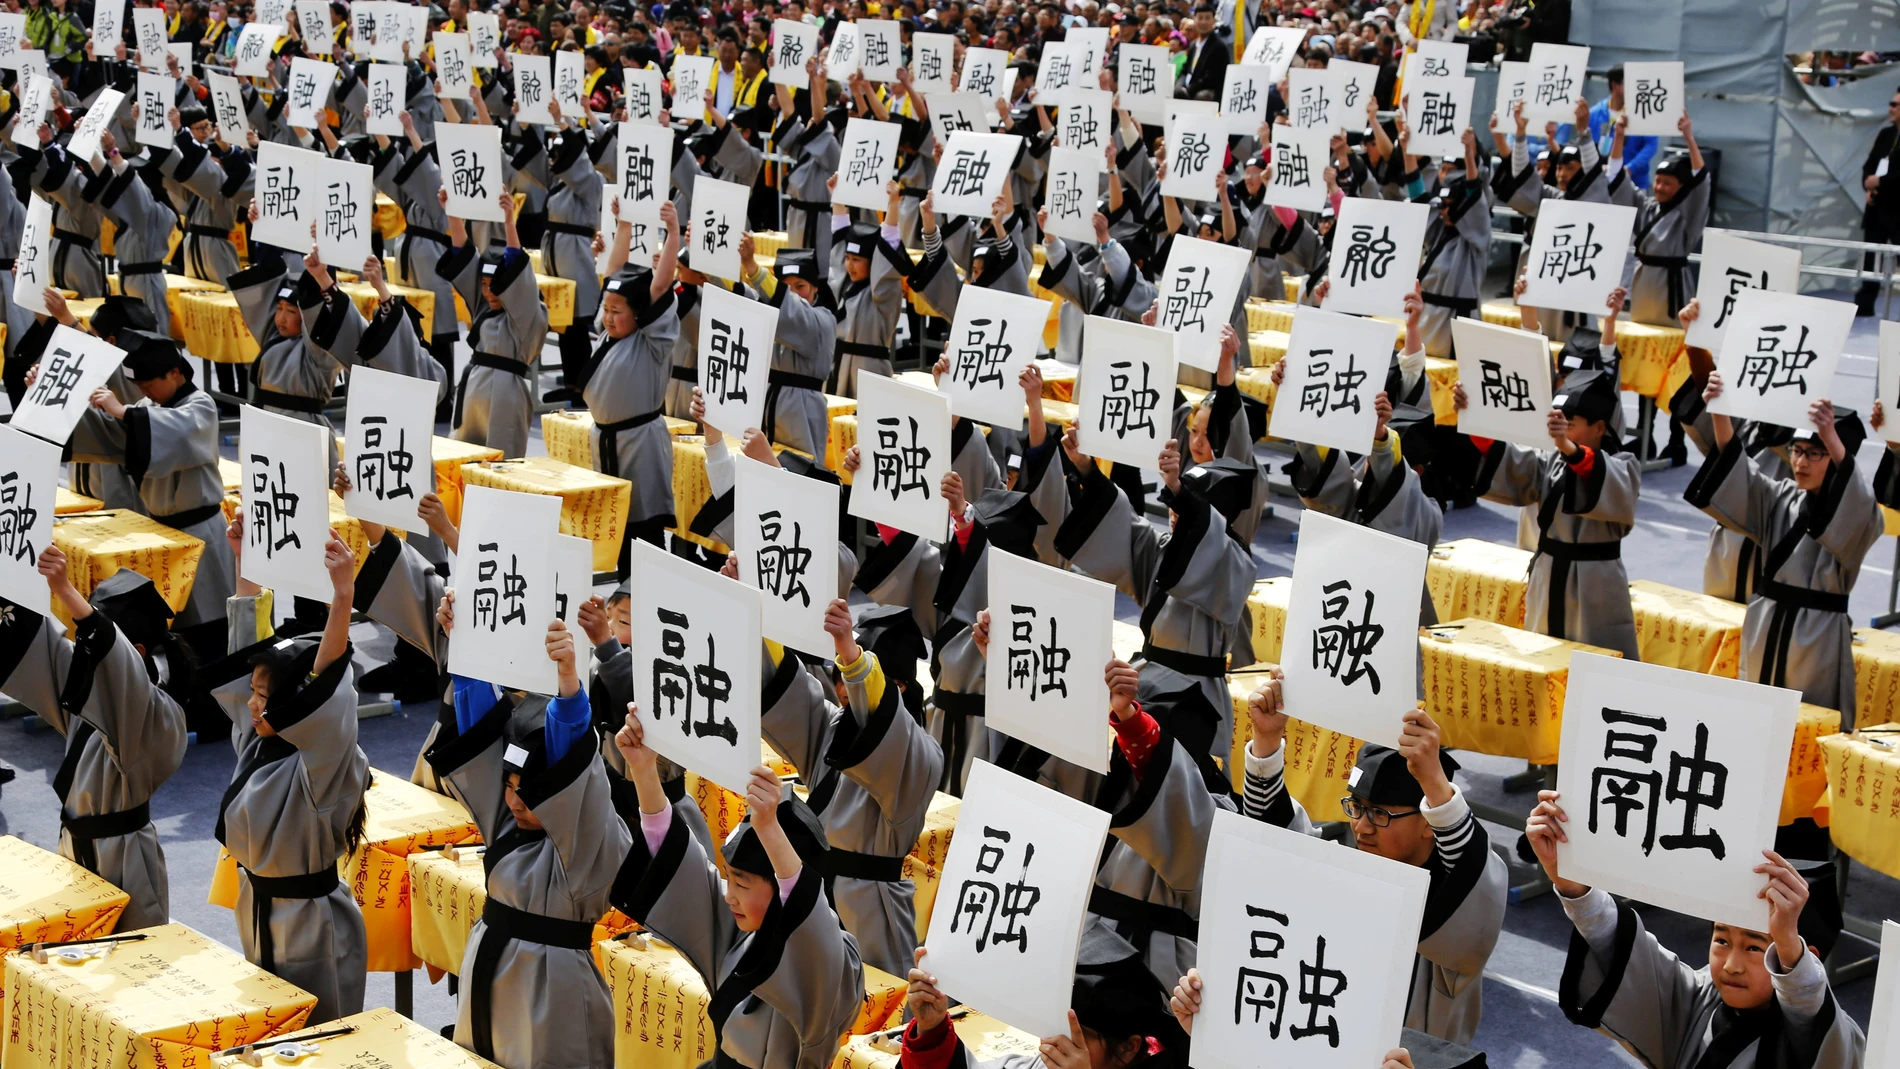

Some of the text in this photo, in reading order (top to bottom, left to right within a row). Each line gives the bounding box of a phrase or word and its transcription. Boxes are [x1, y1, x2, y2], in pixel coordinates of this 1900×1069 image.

[443, 48, 467, 86] 融
[864, 32, 890, 67] 融
[919, 48, 943, 80] 融
[1047, 56, 1071, 88] 融
[1127, 58, 1155, 94] 融
[371, 78, 394, 119] 融
[630, 82, 652, 119] 融
[966, 62, 995, 97] 融
[1230, 79, 1256, 113] 融
[1298, 86, 1329, 128] 融
[1536, 65, 1572, 106] 融
[1635, 79, 1667, 119] 融
[144, 91, 164, 130] 融
[1066, 106, 1098, 149] 融
[1418, 92, 1456, 135] 融
[451, 149, 487, 199] 融
[624, 144, 654, 201] 融
[846, 140, 883, 186] 融
[942, 150, 990, 196] 融
[1275, 143, 1310, 187] 融
[263, 166, 300, 221] 融
[326, 182, 357, 242] 融
[1051, 172, 1082, 219] 融
[703, 210, 729, 254] 融
[1539, 223, 1603, 284] 融
[1163, 266, 1213, 333] 融
[30, 348, 84, 409] 融
[706, 318, 749, 405] 融
[953, 319, 1012, 390] 融
[1737, 325, 1817, 396] 融
[1099, 361, 1160, 439] 融
[1300, 349, 1367, 418] 融
[1479, 360, 1536, 412] 融
[357, 416, 414, 501] 融
[873, 416, 931, 501] 融
[0, 471, 42, 572] 融
[251, 454, 301, 559] 融
[757, 510, 812, 608] 融
[474, 543, 527, 632] 融
[1008, 604, 1071, 701] 融
[1313, 580, 1384, 695] 融
[653, 607, 738, 747] 融
[1588, 707, 1728, 861] 融
[950, 826, 1040, 953] 融
[1235, 904, 1348, 1048] 融
